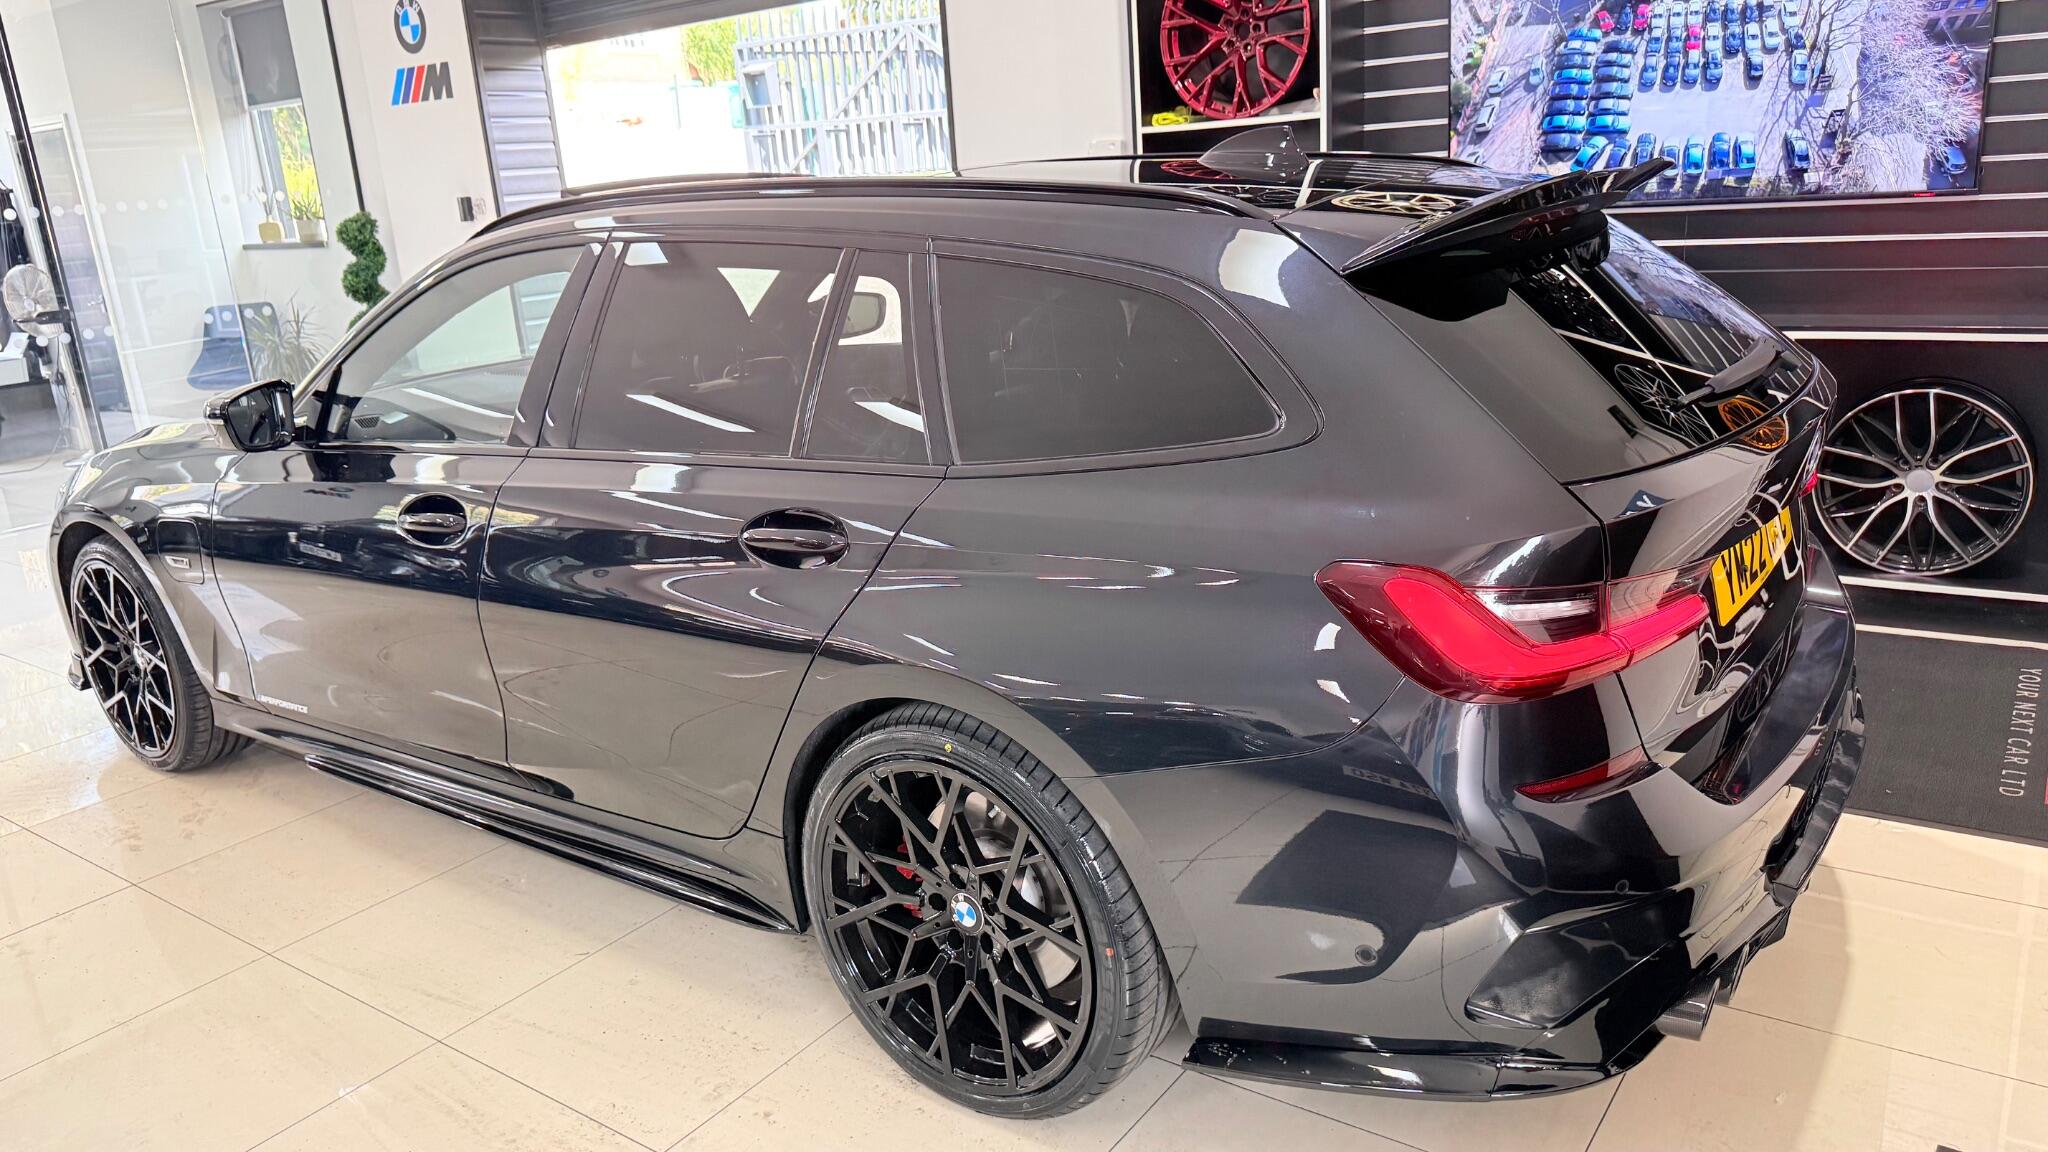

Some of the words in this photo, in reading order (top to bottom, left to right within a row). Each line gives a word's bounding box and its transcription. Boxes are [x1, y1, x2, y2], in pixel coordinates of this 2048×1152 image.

[396, 0, 421, 15] BMW
[2016, 668, 2043, 698] YOUR
[2010, 701, 2038, 735] NEXT
[2003, 737, 2032, 765] CAR
[1999, 769, 2028, 797] LTD
